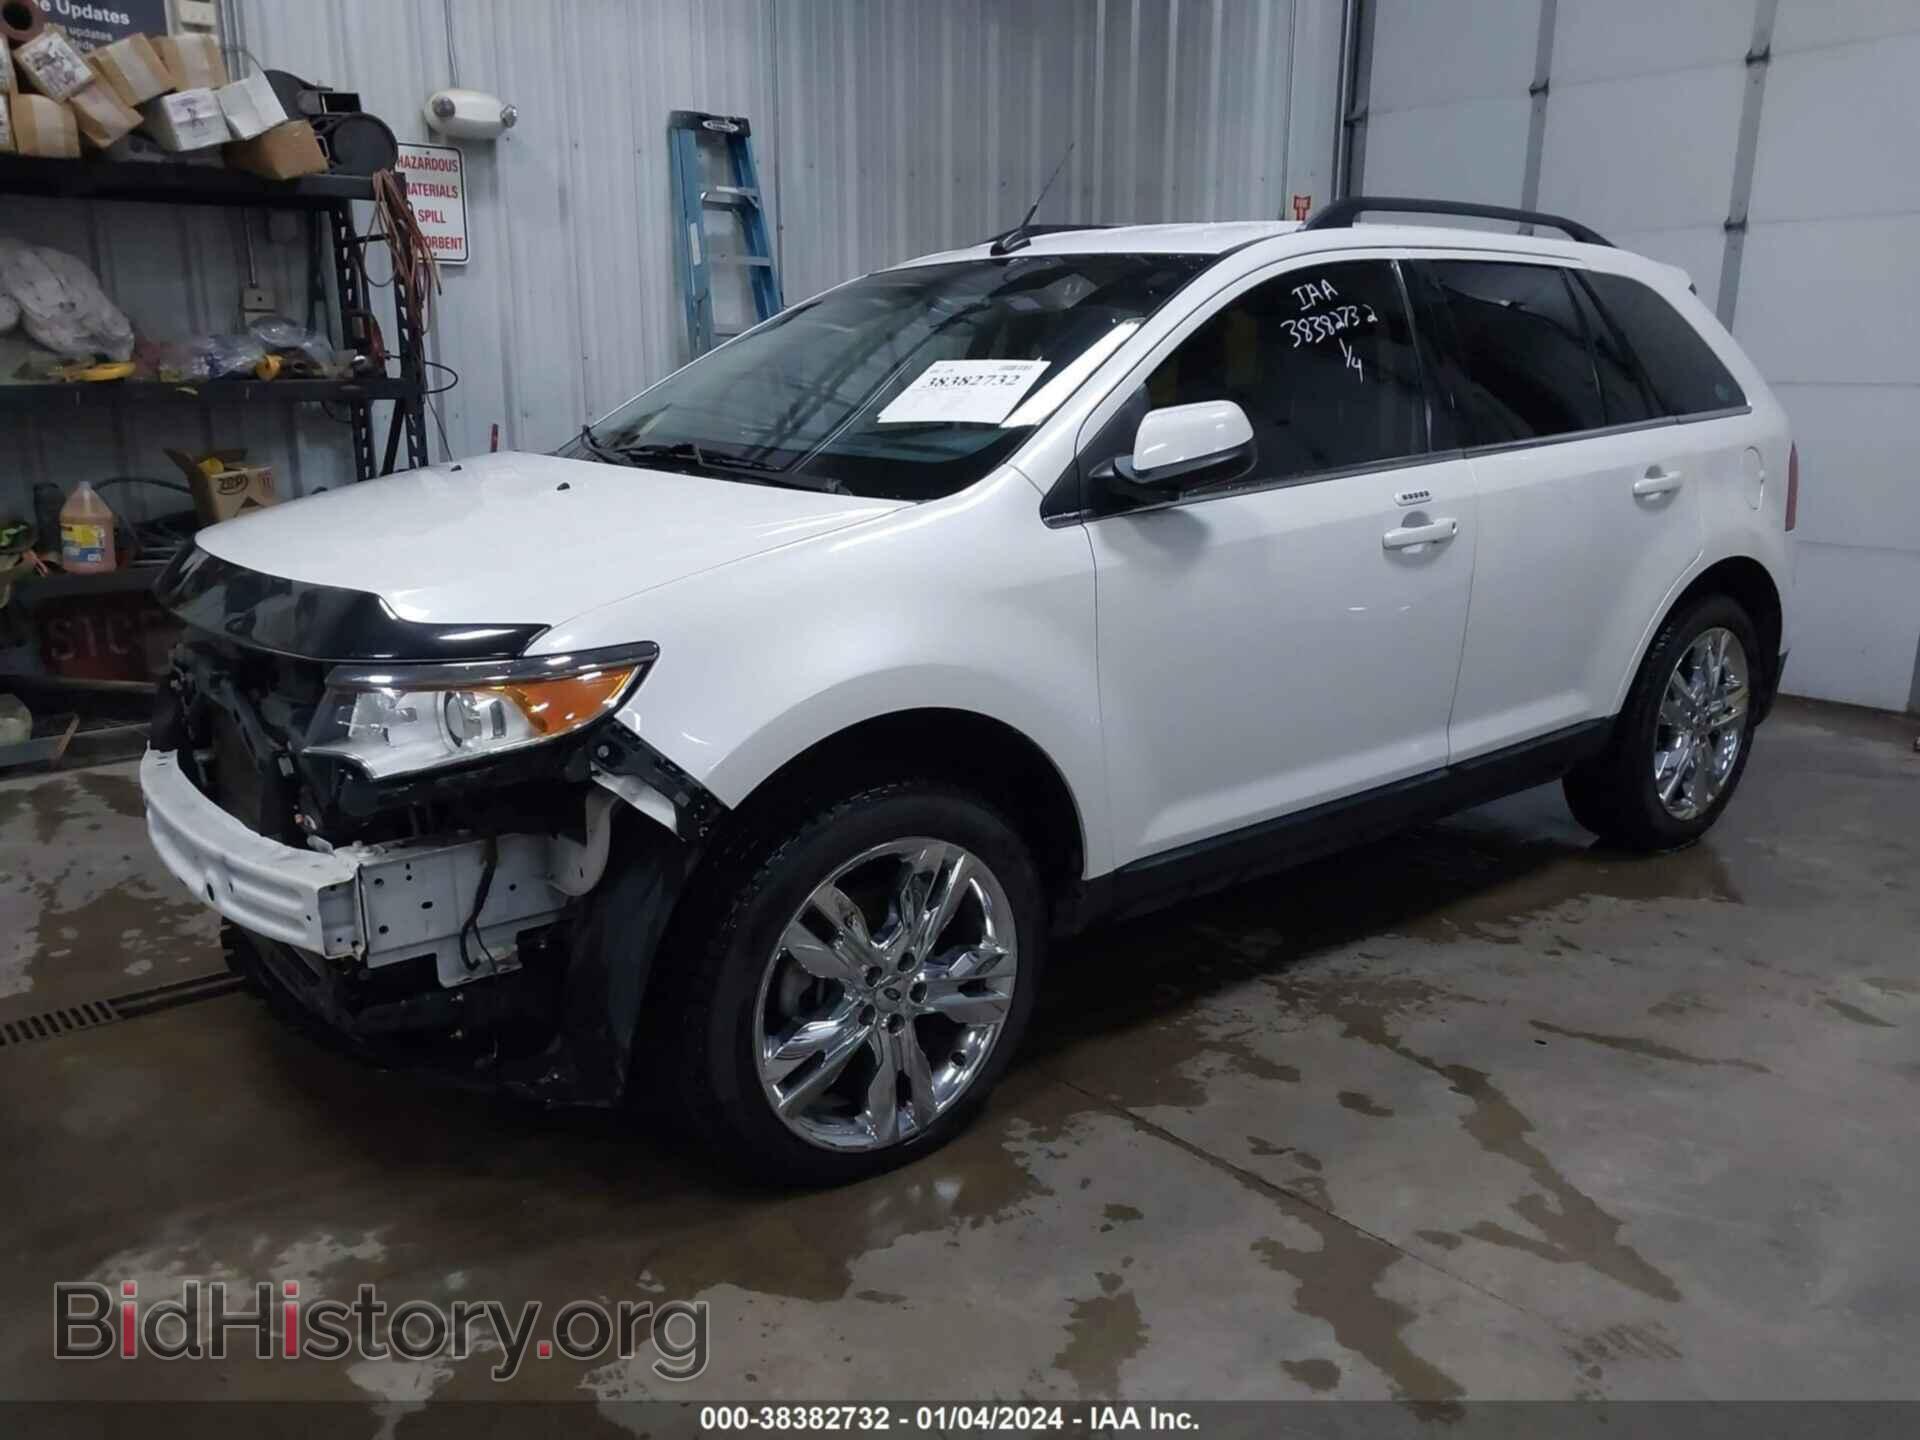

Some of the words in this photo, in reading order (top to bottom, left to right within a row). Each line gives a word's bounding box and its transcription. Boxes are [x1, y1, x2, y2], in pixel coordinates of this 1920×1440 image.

[56, 0, 130, 25] Updates
[398, 155, 458, 173] HAZARDOUS
[418, 209, 446, 224] SPILL
[423, 236, 463, 251] ORBENT
[1291, 279, 1338, 311] IAA
[923, 375, 1019, 388] 38382732
